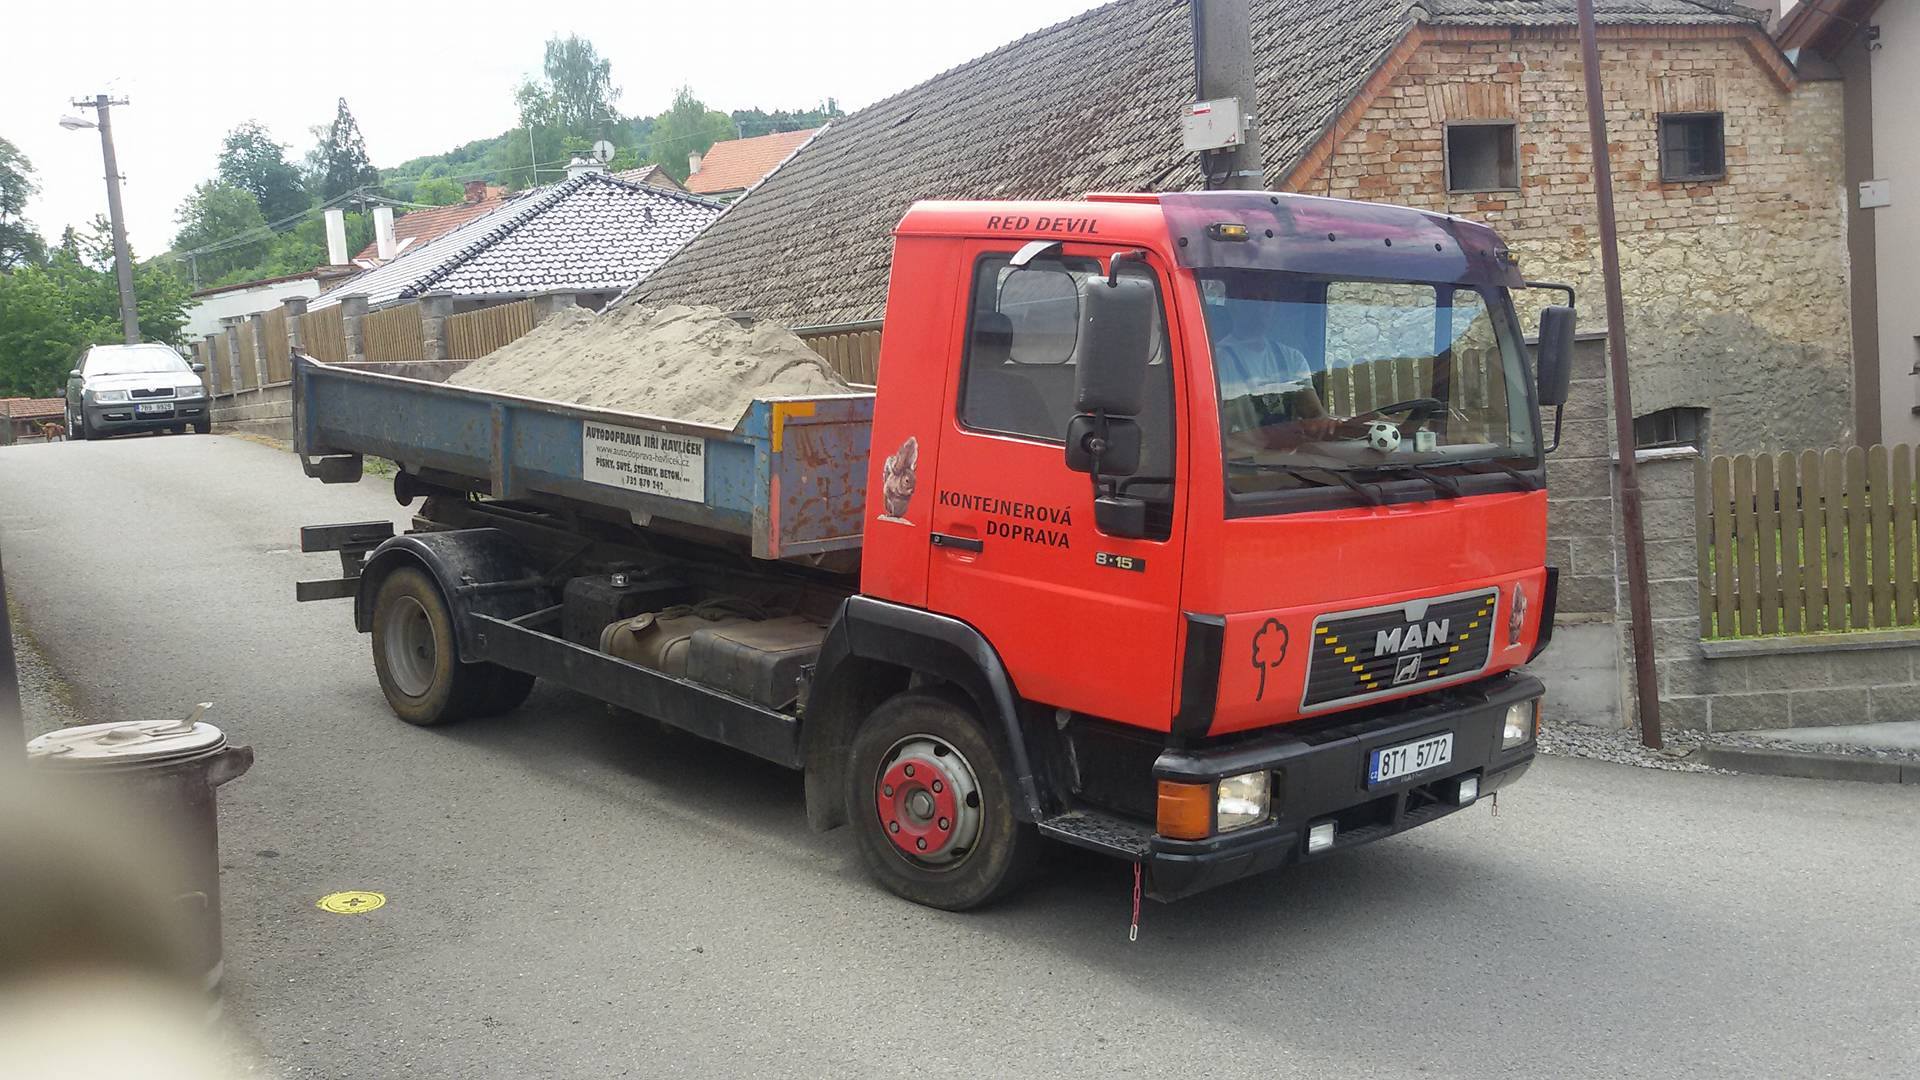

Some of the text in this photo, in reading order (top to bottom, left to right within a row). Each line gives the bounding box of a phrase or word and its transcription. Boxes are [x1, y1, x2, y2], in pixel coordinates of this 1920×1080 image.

[987, 216, 1099, 234] RED DEVIL
[586, 426, 702, 456] AUTODOPRAVA JIŘÍ HAVLÍČEK
[939, 490, 1072, 526] KONTEJNEROVÁ
[986, 520, 1070, 548] DOPRAVA
[1374, 619, 1449, 656] MAN
[1382, 748, 1407, 776] 8T1
[1416, 738, 1447, 768] 5772
